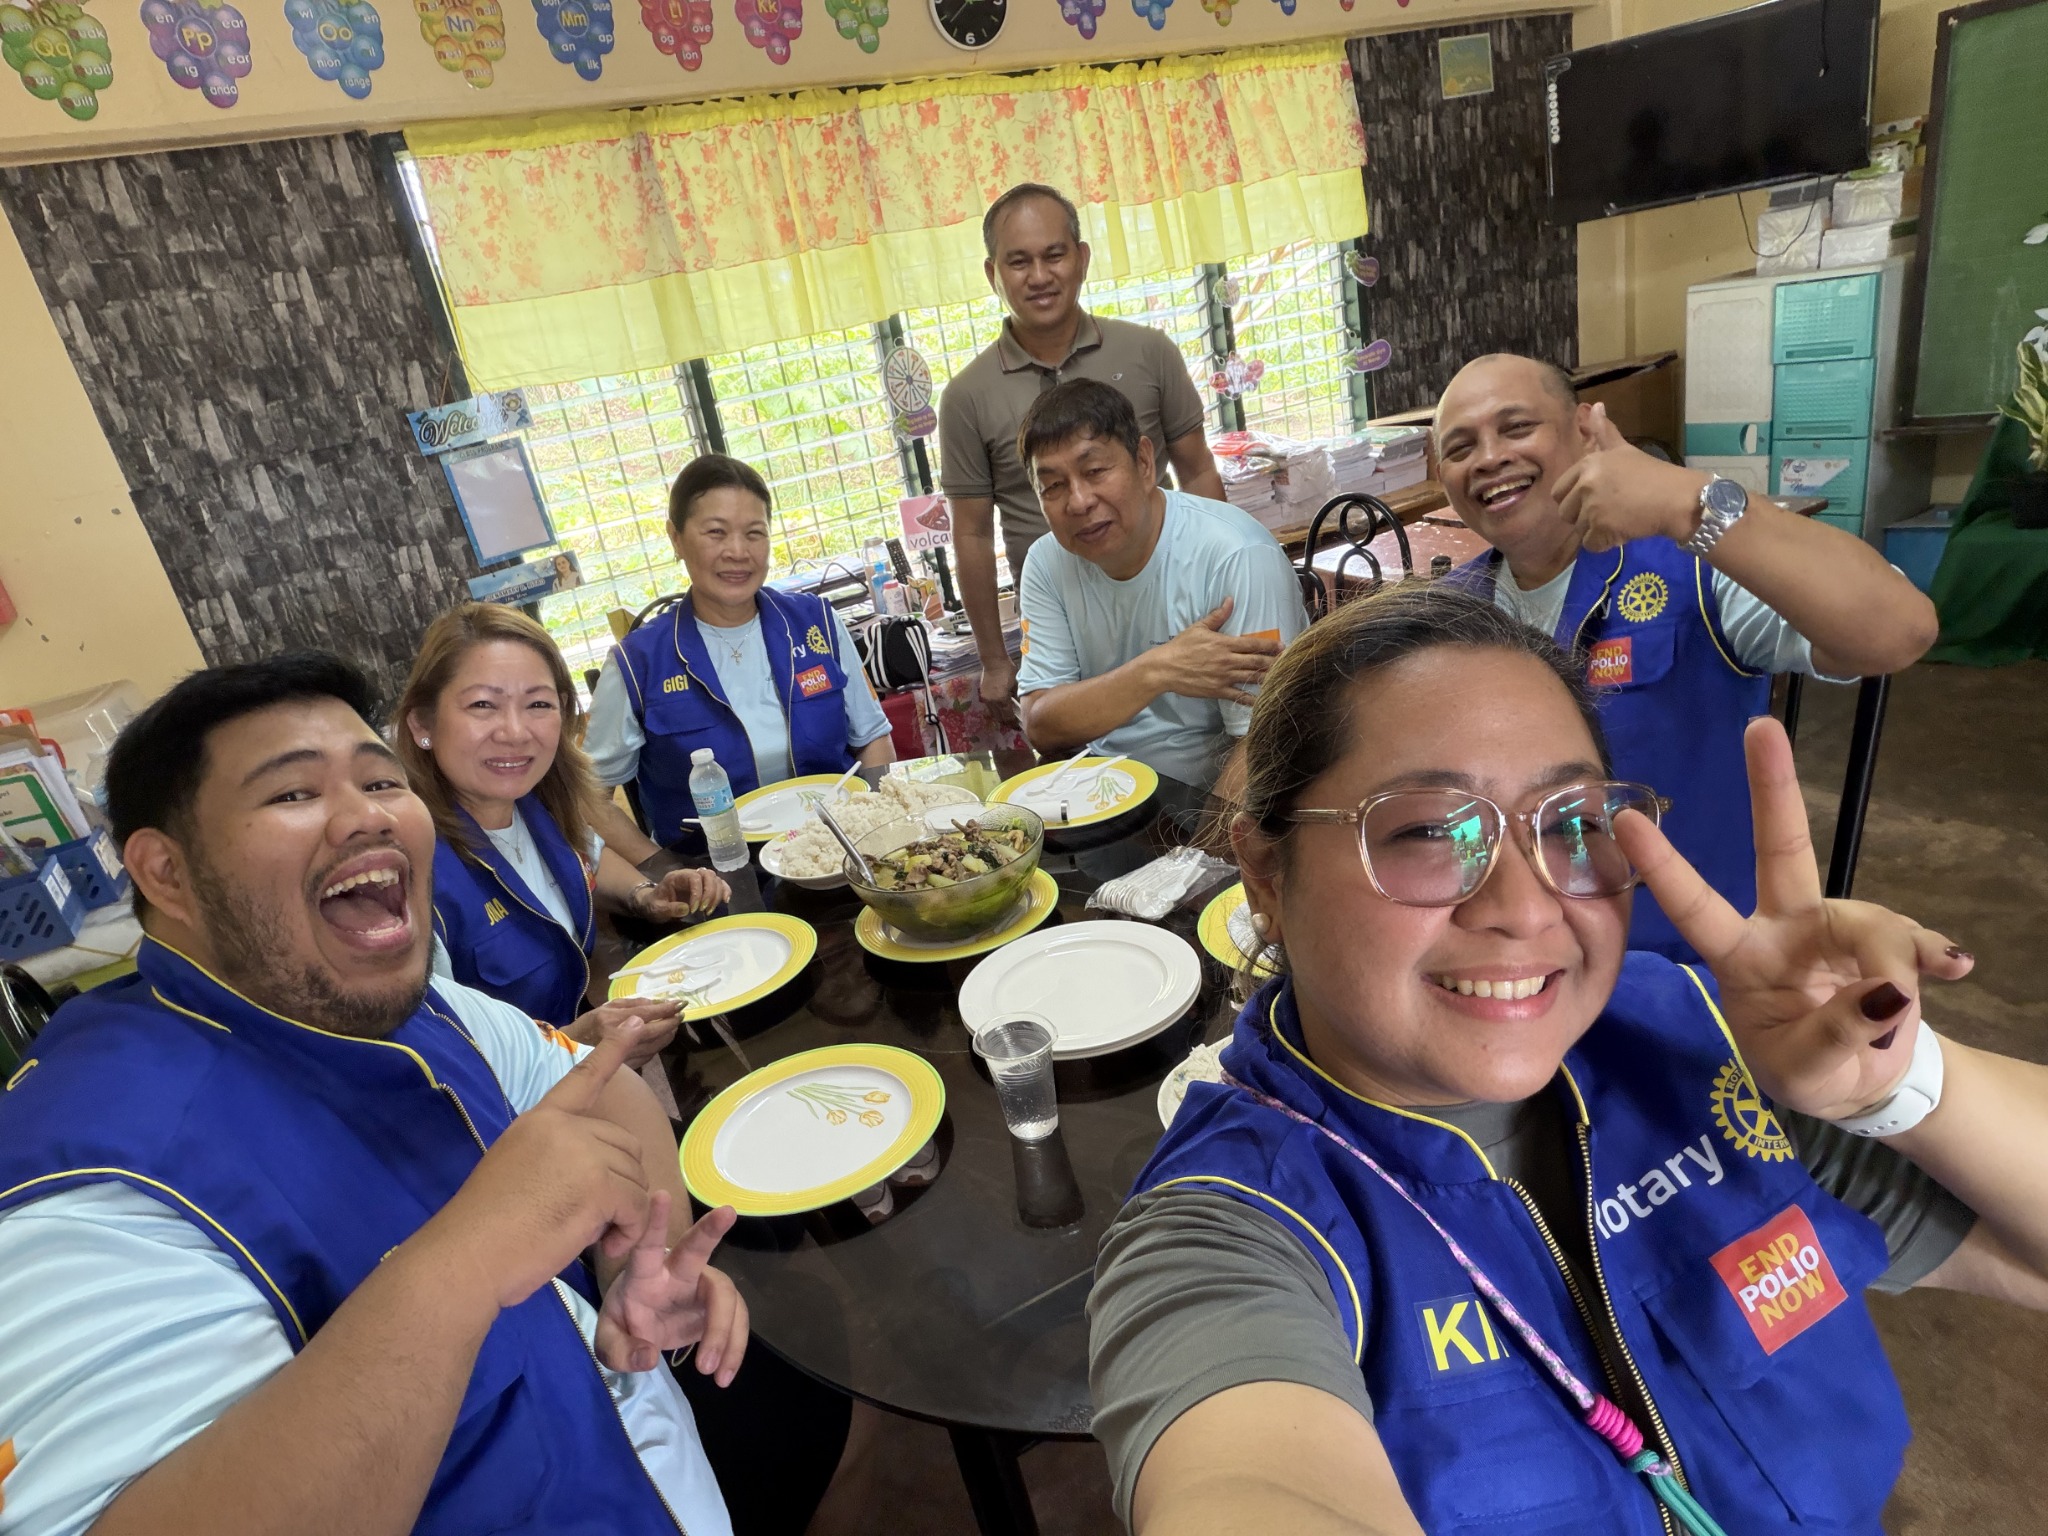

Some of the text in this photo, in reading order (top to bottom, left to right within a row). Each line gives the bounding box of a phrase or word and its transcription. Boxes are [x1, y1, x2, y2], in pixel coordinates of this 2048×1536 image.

[446, 15, 475, 33] Nn
[560, 10, 588, 28] Mm
[181, 28, 214, 51] Pp
[319, 22, 352, 40] Oo
[965, 32, 976, 45] 6
[34, 38, 74, 61] Qq
[909, 531, 951, 549] volca
[1596, 645, 1623, 658] END
[1590, 653, 1629, 669] POLIO
[801, 669, 821, 682] END
[1595, 664, 1626, 679] NOW
[663, 674, 689, 694] GIGI
[800, 673, 827, 689] POLIO
[805, 681, 827, 693] NOW
[1738, 1232, 1800, 1284] END
[1738, 1245, 1820, 1313] POLIO
[1759, 1267, 1826, 1328] NOW
[1423, 1299, 1510, 1371] KI
